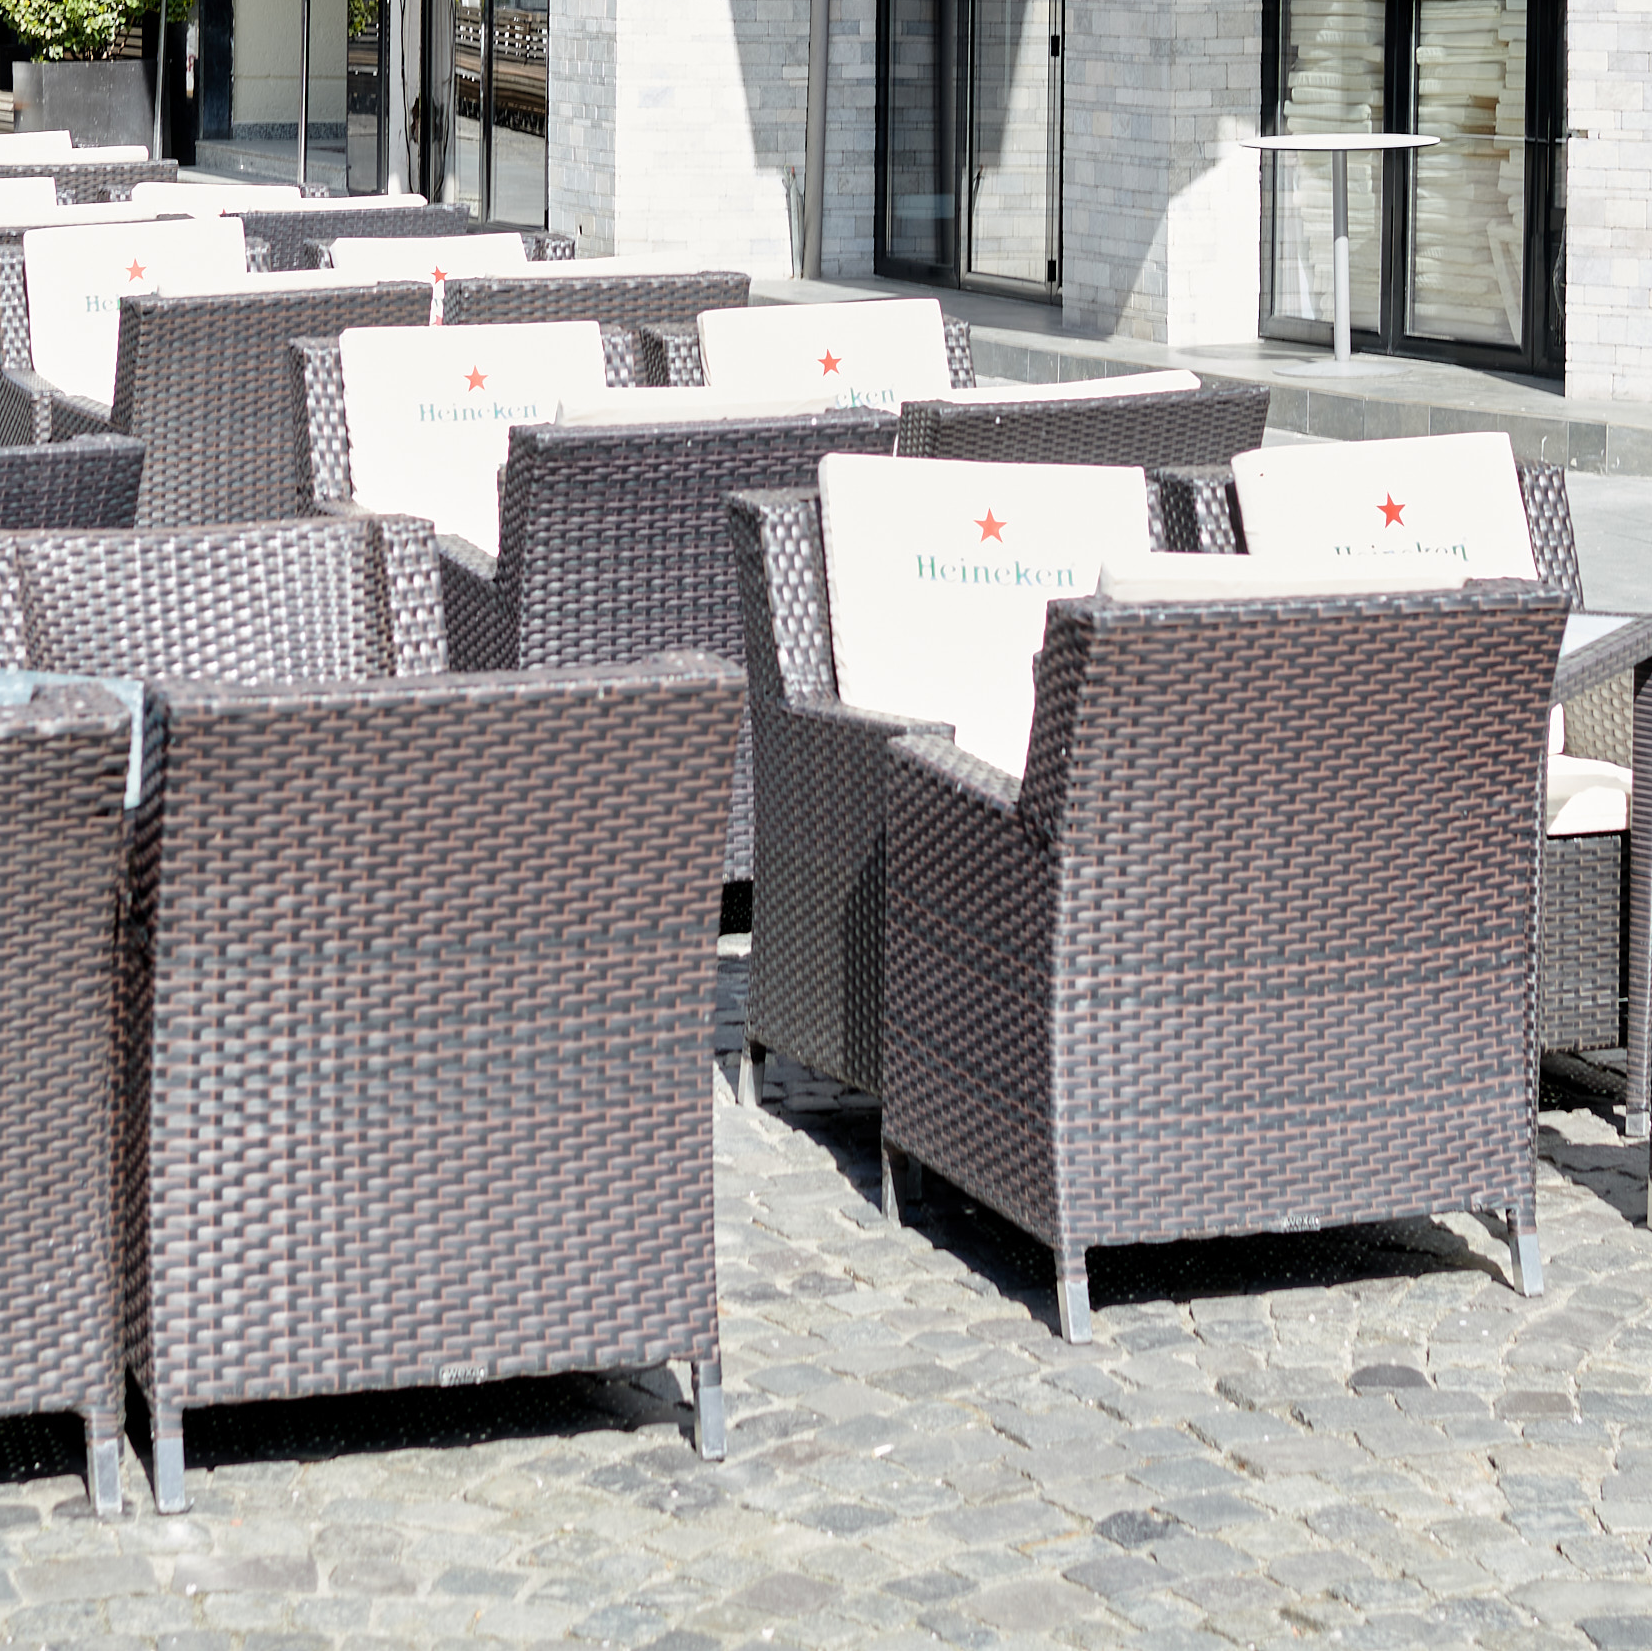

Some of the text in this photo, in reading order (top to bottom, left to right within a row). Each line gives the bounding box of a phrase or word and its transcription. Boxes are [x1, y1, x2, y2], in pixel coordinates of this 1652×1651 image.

[835, 386, 895, 410] eken
[418, 400, 538, 422] Heineken
[916, 554, 1075, 588] Heineken
